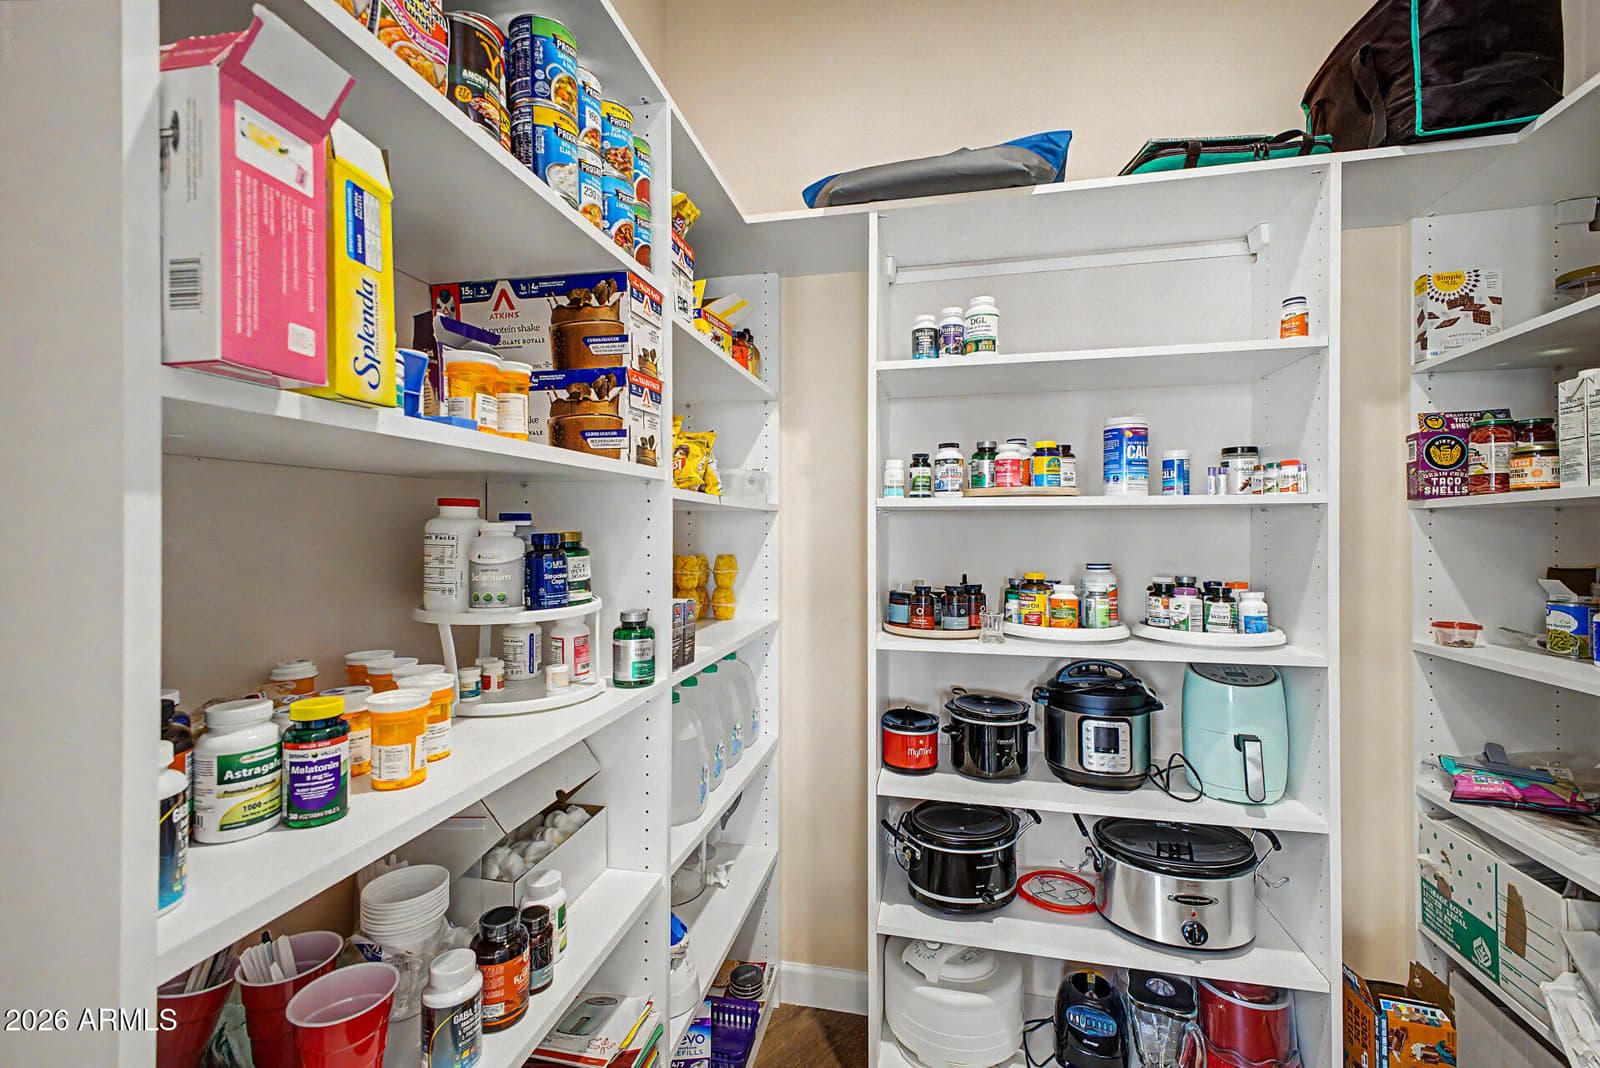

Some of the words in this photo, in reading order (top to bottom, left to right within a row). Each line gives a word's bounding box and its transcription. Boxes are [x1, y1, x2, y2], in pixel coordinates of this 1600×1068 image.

[489, 311, 520, 320] ATKINS
[970, 317, 987, 326] DGL
[353, 277, 381, 390] Splenda
[518, 324, 541, 333] shake
[1424, 486, 1469, 496] SHELLS
[471, 572, 511, 582] Selenium
[290, 761, 340, 775] Melatonin
[1360, 1012, 1368, 1050] SODA
